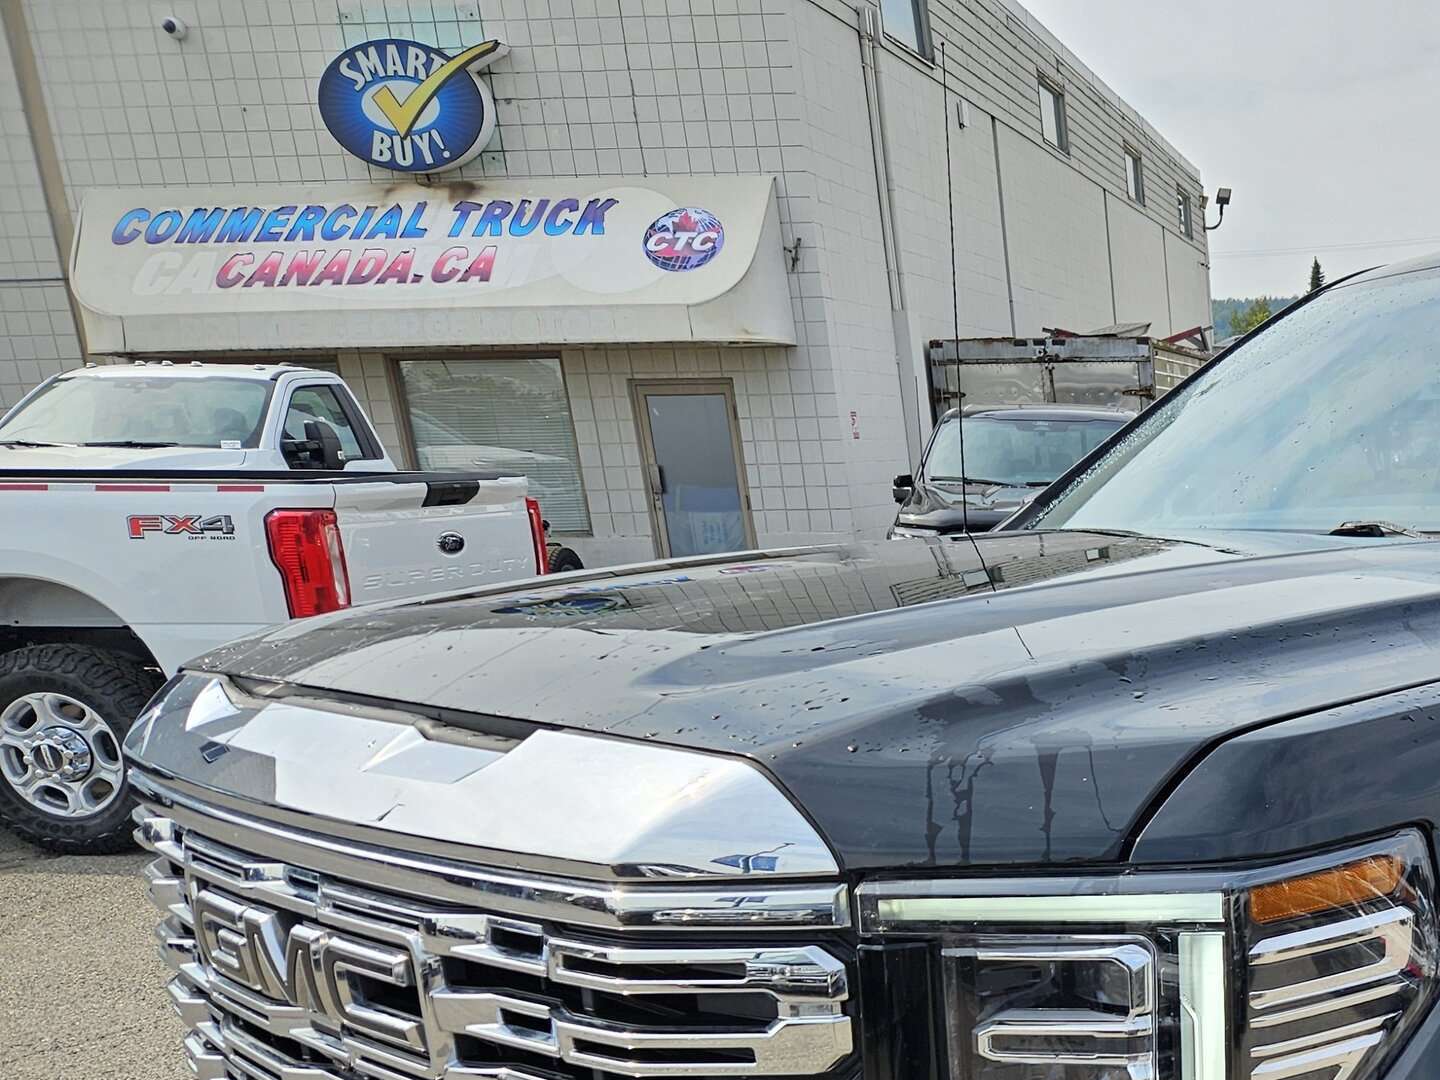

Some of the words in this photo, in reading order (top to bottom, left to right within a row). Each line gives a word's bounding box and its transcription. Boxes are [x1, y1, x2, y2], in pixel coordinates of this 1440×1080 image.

[338, 44, 448, 92] SMART
[371, 128, 451, 167] BUY!
[111, 201, 428, 245] COMMERCIAL
[447, 197, 620, 238] TRUCK
[645, 230, 720, 255] CTC
[215, 244, 499, 289] CANADA.CA
[126, 514, 236, 540] FX4
[363, 566, 465, 591] SUPER
[470, 556, 530, 577] DUTY
[197, 888, 429, 1056] GMC
